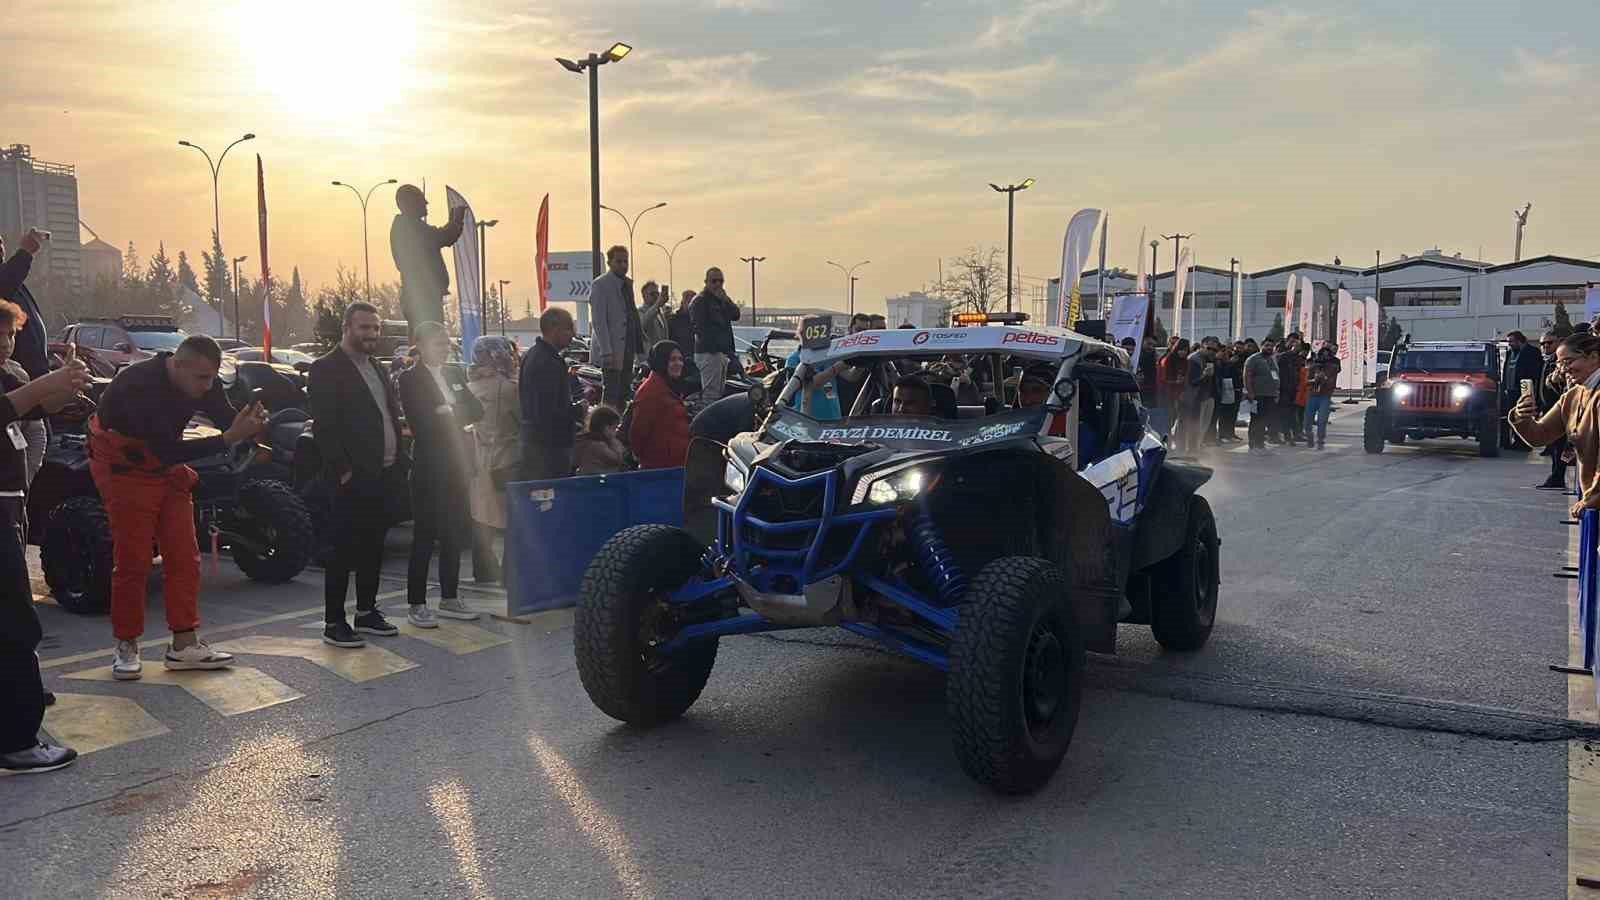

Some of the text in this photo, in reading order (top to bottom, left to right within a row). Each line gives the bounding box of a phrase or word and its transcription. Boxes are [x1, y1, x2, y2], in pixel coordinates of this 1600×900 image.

[806, 324, 827, 340] 052
[1002, 331, 1058, 345] petlas
[819, 425, 868, 440] FEYZİ
[871, 427, 953, 442] DEMİREL
